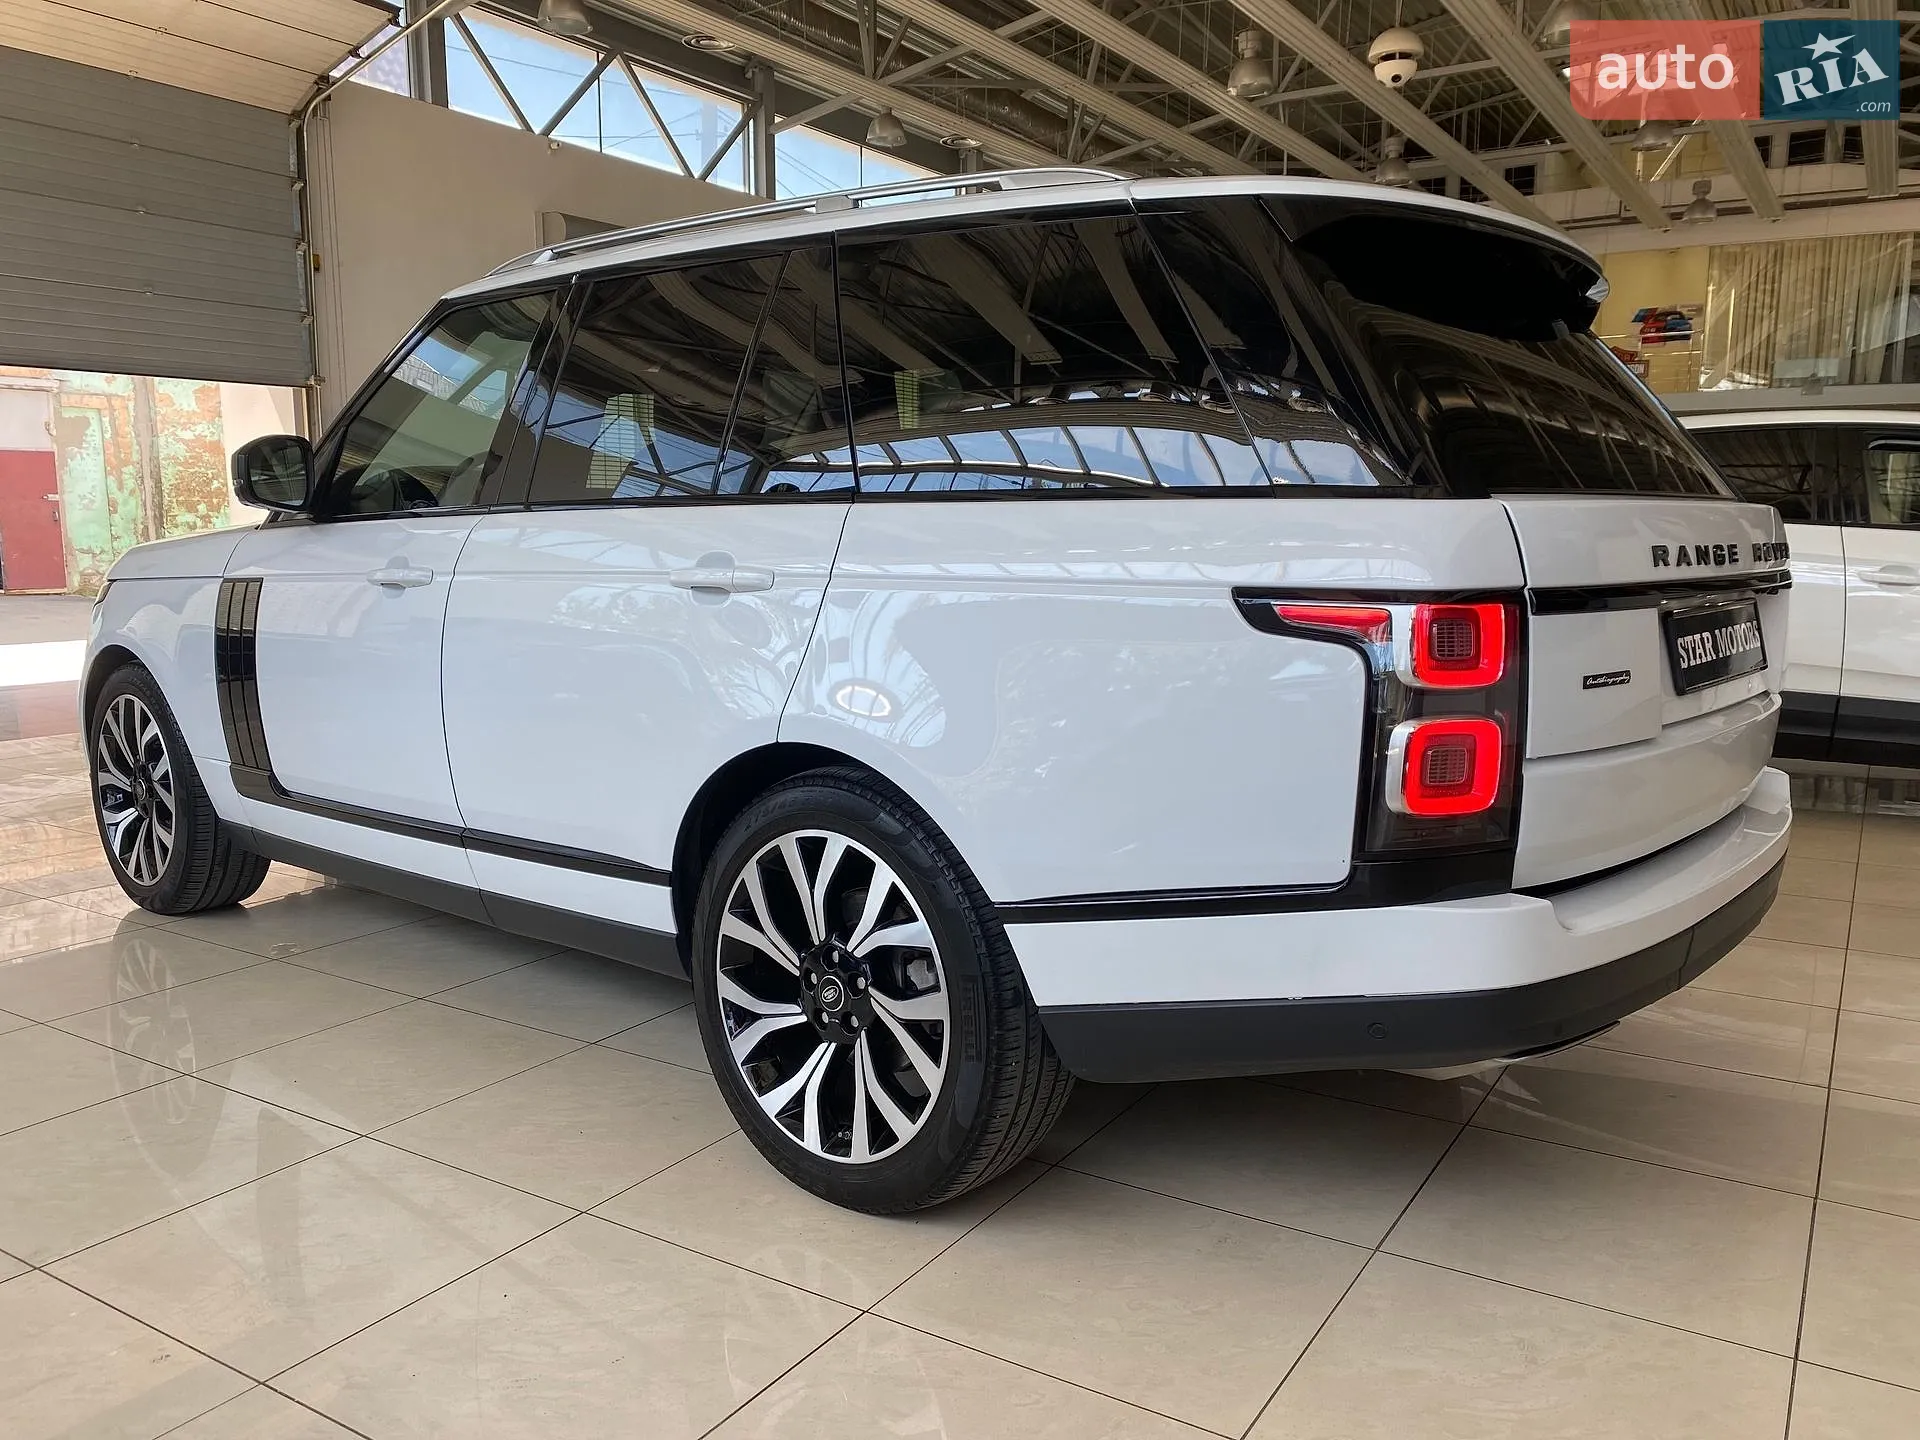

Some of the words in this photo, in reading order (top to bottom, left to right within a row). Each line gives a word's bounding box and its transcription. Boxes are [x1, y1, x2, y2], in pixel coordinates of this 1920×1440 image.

[1652, 544, 1739, 567] RANGE
[1677, 631, 1716, 669] STAR
[1714, 620, 1760, 658] MOTORS
